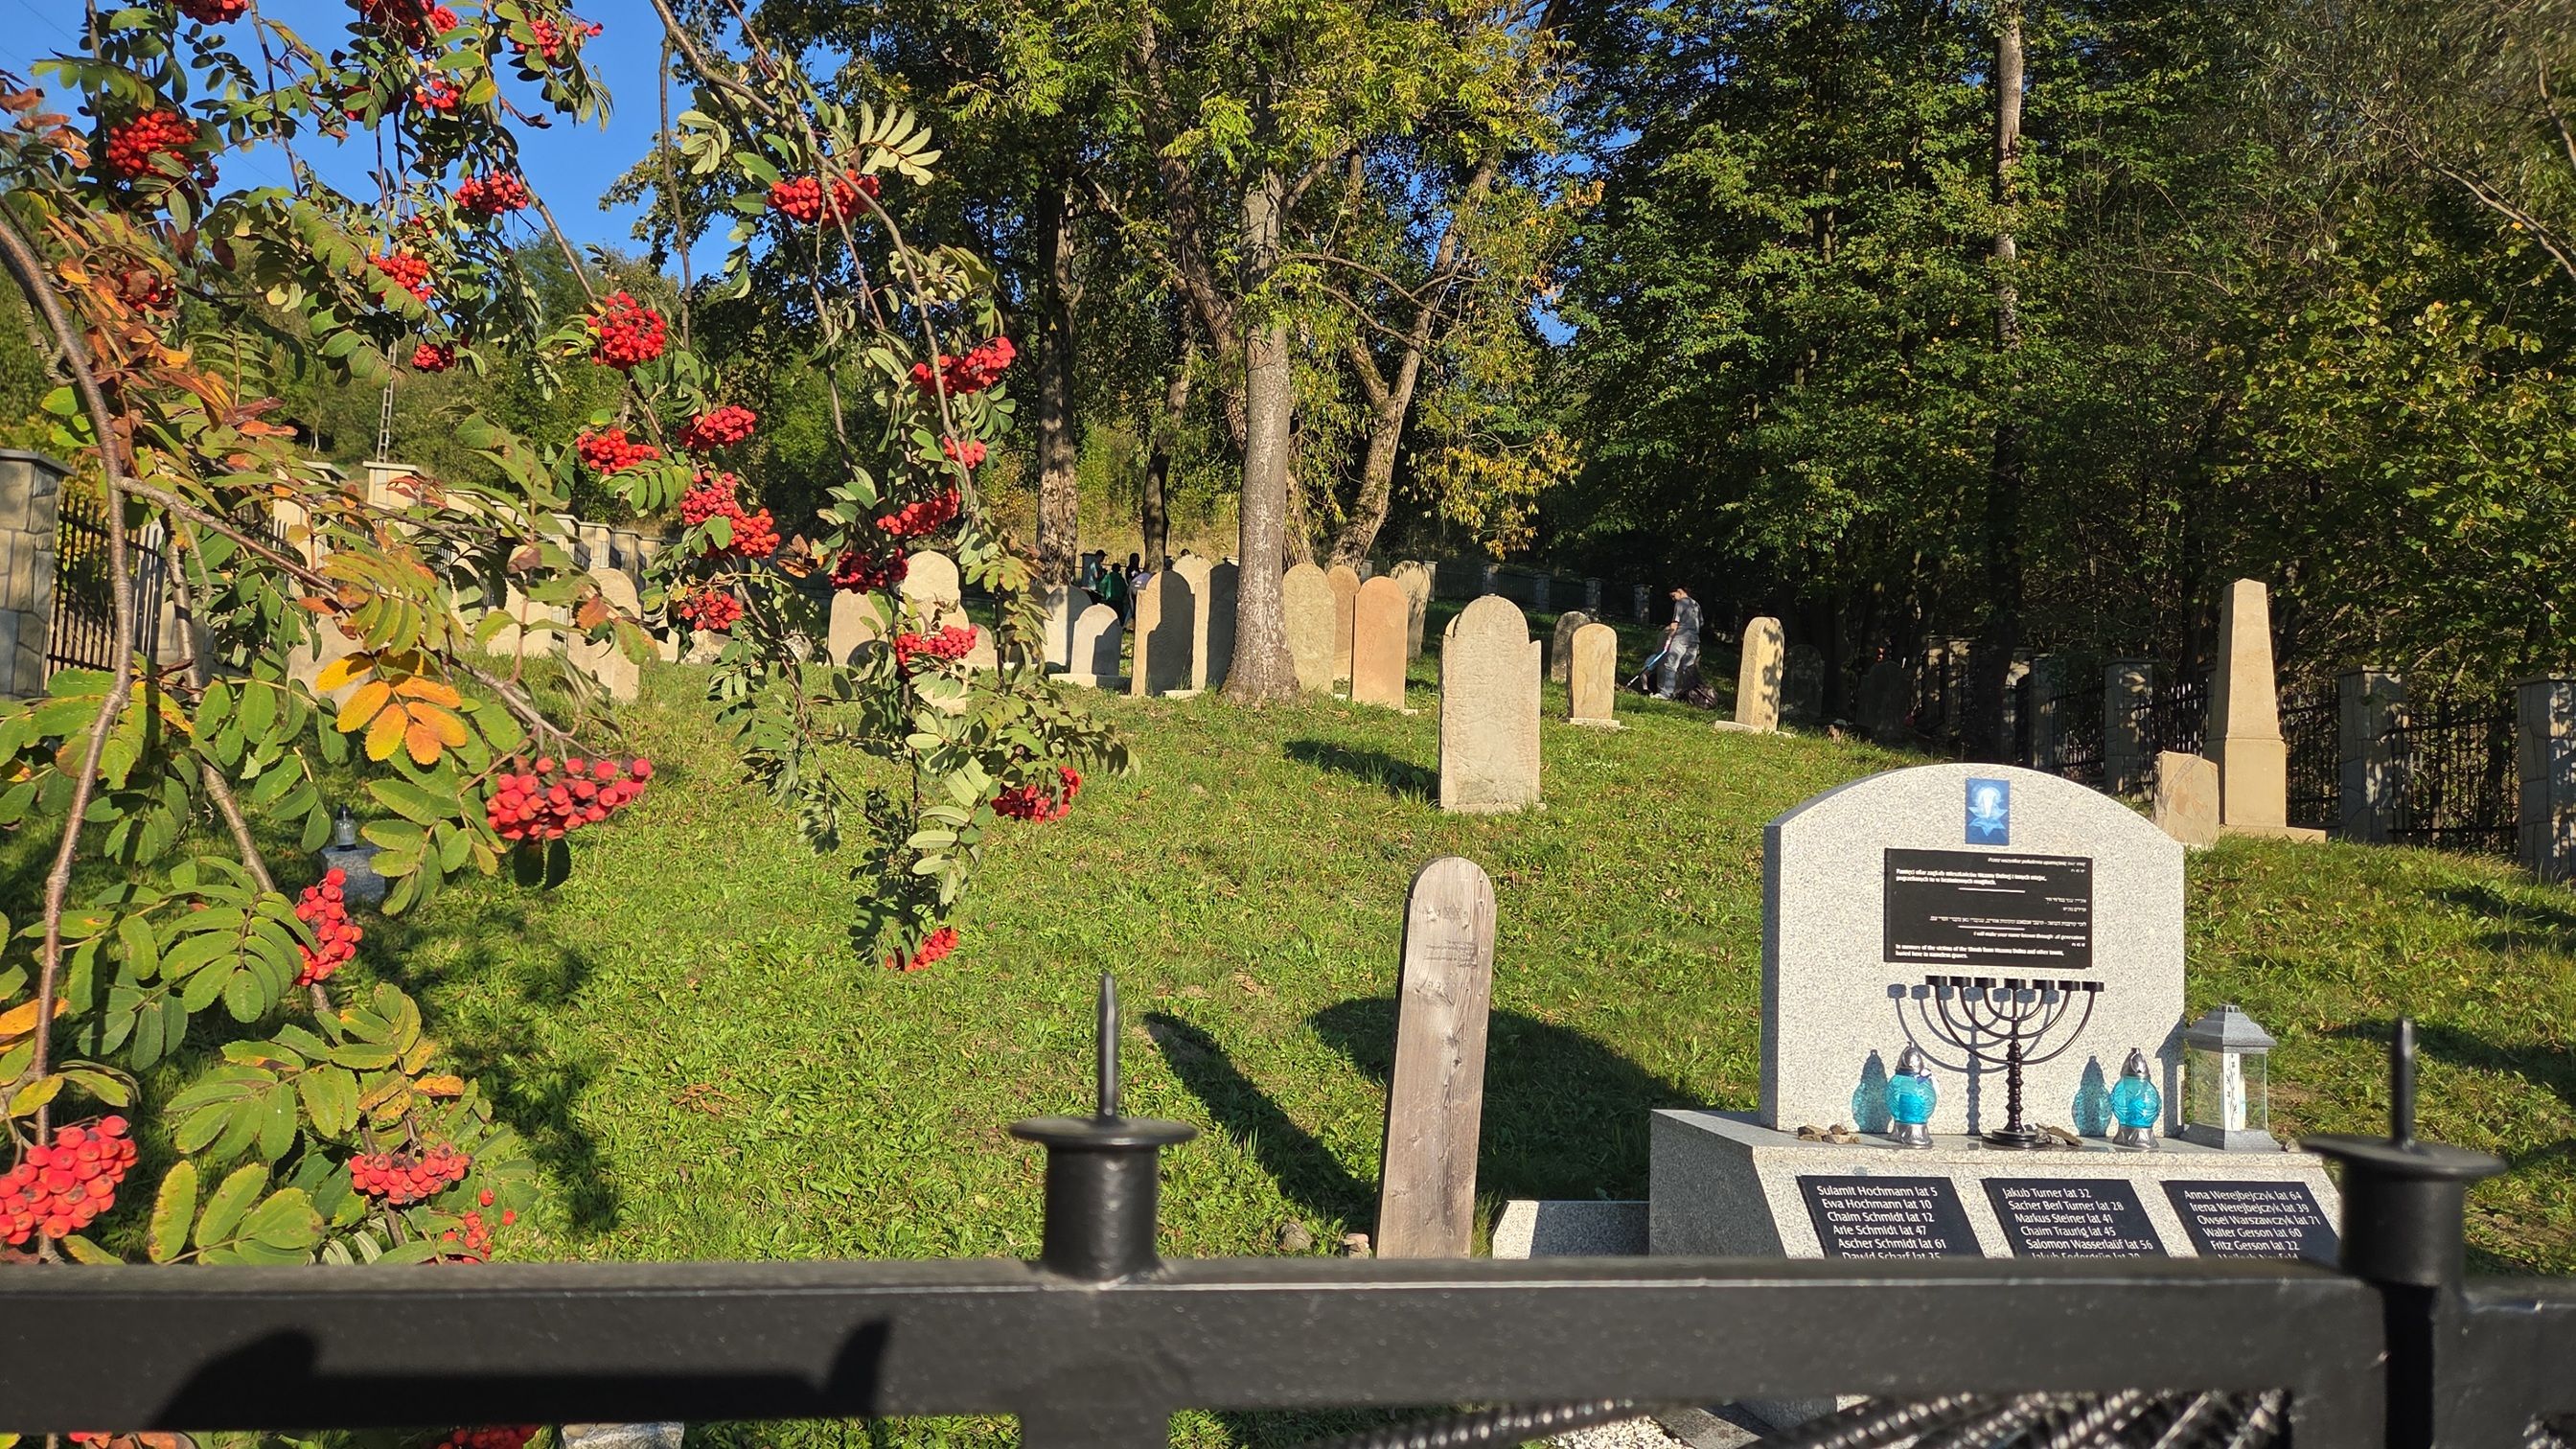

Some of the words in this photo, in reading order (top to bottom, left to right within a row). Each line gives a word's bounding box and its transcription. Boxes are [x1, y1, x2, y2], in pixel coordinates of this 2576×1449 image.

[1817, 1185, 1856, 1196] Sulamit
[1859, 1186, 1914, 1197] Hochmann
[1916, 1186, 1929, 1197] lat
[1931, 1187, 1938, 1197] 5
[2002, 1188, 2030, 1199] Jakub
[2032, 1188, 2062, 1198] Turner
[2065, 1188, 2078, 1198] lat
[2080, 1189, 2091, 1198] 32
[2275, 1191, 2287, 1200] lat
[1823, 1199, 1846, 1208] Ewa
[1847, 1199, 1904, 1209] Hochmann
[1904, 1199, 1918, 1209] lat
[1920, 1200, 1932, 1209] 10
[2009, 1201, 2041, 1210] Sacher
[2044, 1201, 2061, 1210] Berl
[2063, 1202, 2094, 1210] Turner
[2096, 1202, 2109, 1210] lat
[2111, 1202, 2124, 1210] 28
[2190, 1204, 2216, 1212] Irena
[2283, 1204, 2295, 1212] lat
[2297, 1205, 2310, 1213] 39
[1828, 1212, 1860, 1222] Chaim
[1864, 1212, 1904, 1223] Schmidt
[1907, 1212, 1920, 1223] lat
[1921, 1213, 1935, 1222] 12
[2014, 1213, 2051, 1223] Markus
[2054, 1214, 2085, 1223] Steiner
[2088, 1214, 2101, 1223] lat
[2103, 1214, 2113, 1223] 41
[2229, 1216, 2292, 1227] Warszawczyk
[2294, 1216, 2309, 1225] lat
[2310, 1217, 2320, 1226] 71
[1833, 1226, 1853, 1235] Arie
[1857, 1226, 1898, 1235] Schmidt
[1899, 1226, 1913, 1235] lat
[1915, 1226, 1926, 1235] 47
[2021, 1226, 2052, 1236] Chaim
[2055, 1227, 2087, 1237] Traurig
[2089, 1227, 2102, 1236] lat
[2104, 1228, 2116, 1236] 45
[2202, 1228, 2235, 1237] Walter
[2238, 1229, 2272, 1237] Gerson
[2274, 1229, 2287, 1237] lat
[2288, 1229, 2302, 1237] 60
[1838, 1238, 1874, 1249] Ascher
[1876, 1239, 1918, 1249] Schmidt
[1920, 1239, 1933, 1249] lat
[1935, 1239, 1946, 1249] 61
[2026, 1239, 2069, 1249] Salomon
[2126, 1240, 2139, 1250] lat
[2140, 1241, 2152, 1250] 56
[2211, 1241, 2232, 1250] Fritz
[2233, 1241, 2270, 1251] Gerson
[2272, 1241, 2285, 1251] lat
[2287, 1242, 2300, 1251] 22
